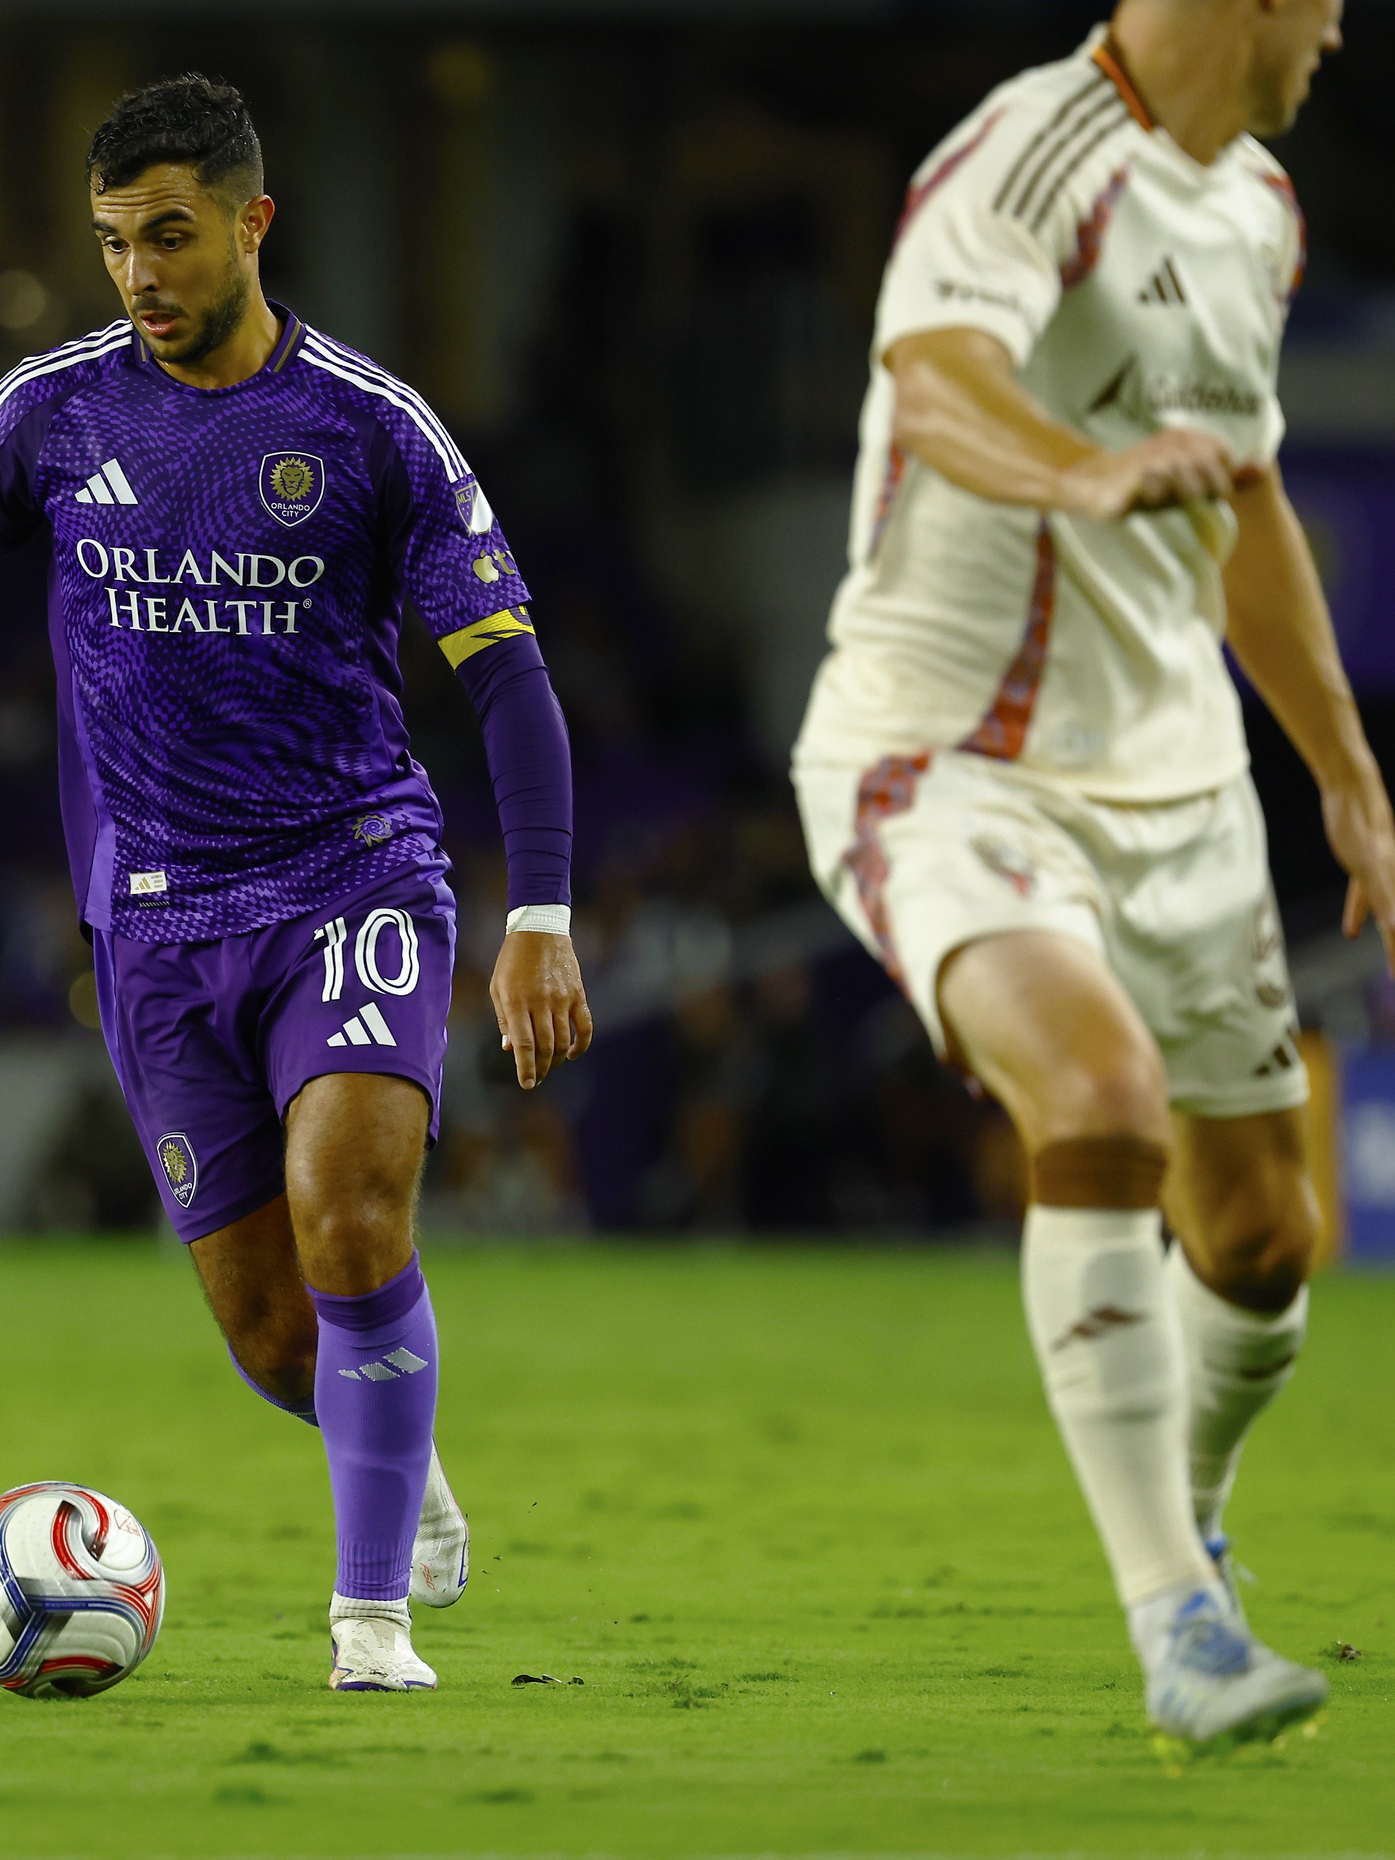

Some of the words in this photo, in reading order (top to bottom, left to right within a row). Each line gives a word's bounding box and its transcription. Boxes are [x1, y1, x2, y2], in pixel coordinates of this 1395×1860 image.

[457, 491, 471, 504] MLS
[270, 502, 311, 512] ORLANDO
[281, 510, 300, 518] CITY
[76, 538, 325, 588] ORLANDO
[313, 907, 421, 1003] 10
